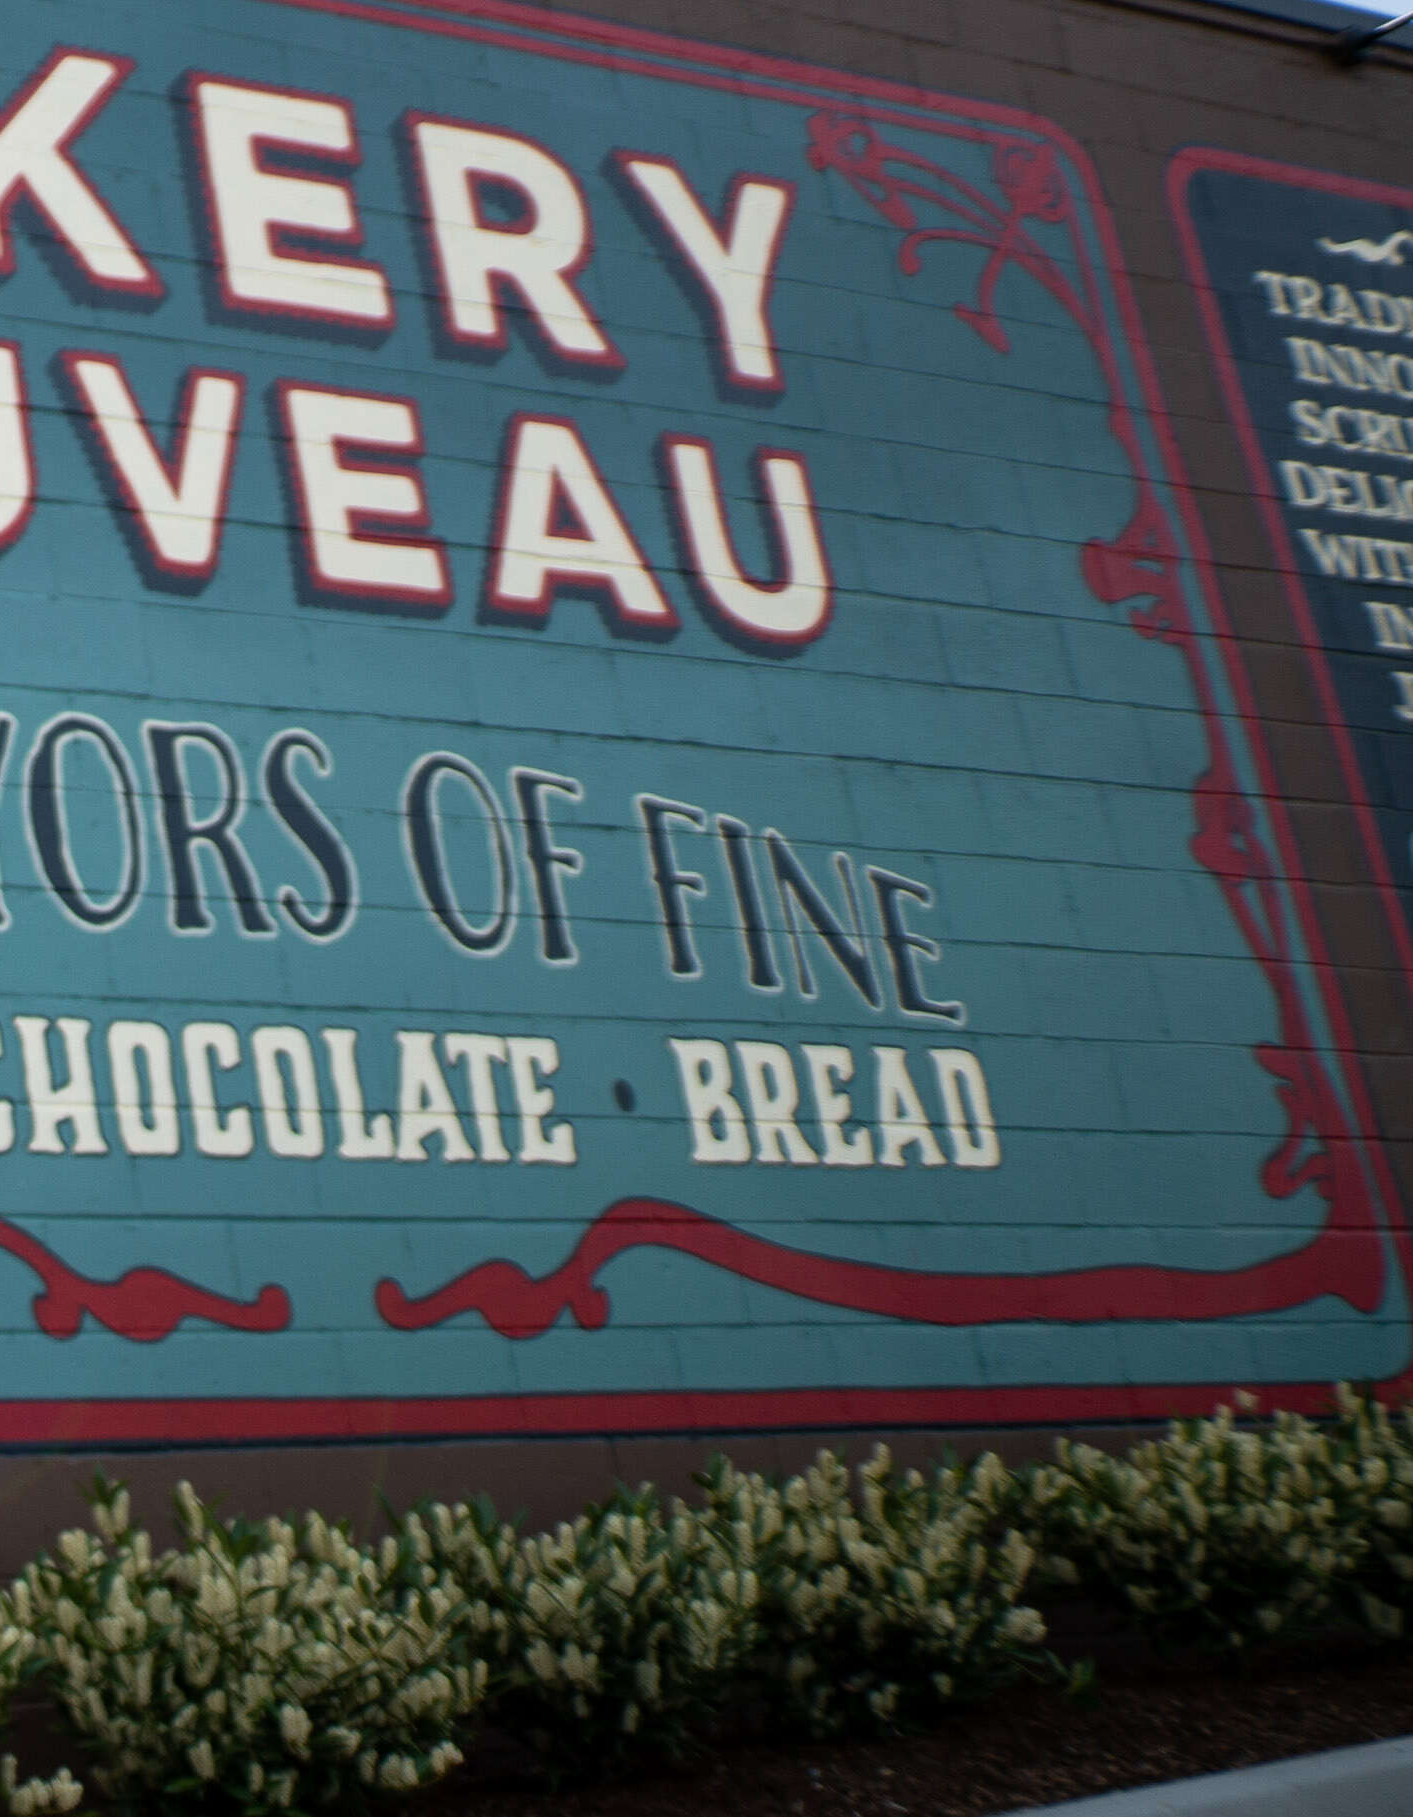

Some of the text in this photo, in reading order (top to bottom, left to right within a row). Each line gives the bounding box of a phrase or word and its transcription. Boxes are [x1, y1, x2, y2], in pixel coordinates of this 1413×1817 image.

[1296, 528, 1413, 584] WIT
[403, 750, 583, 964] OF
[635, 793, 966, 1024] FINE
[669, 1036, 1001, 1168] BREAD
